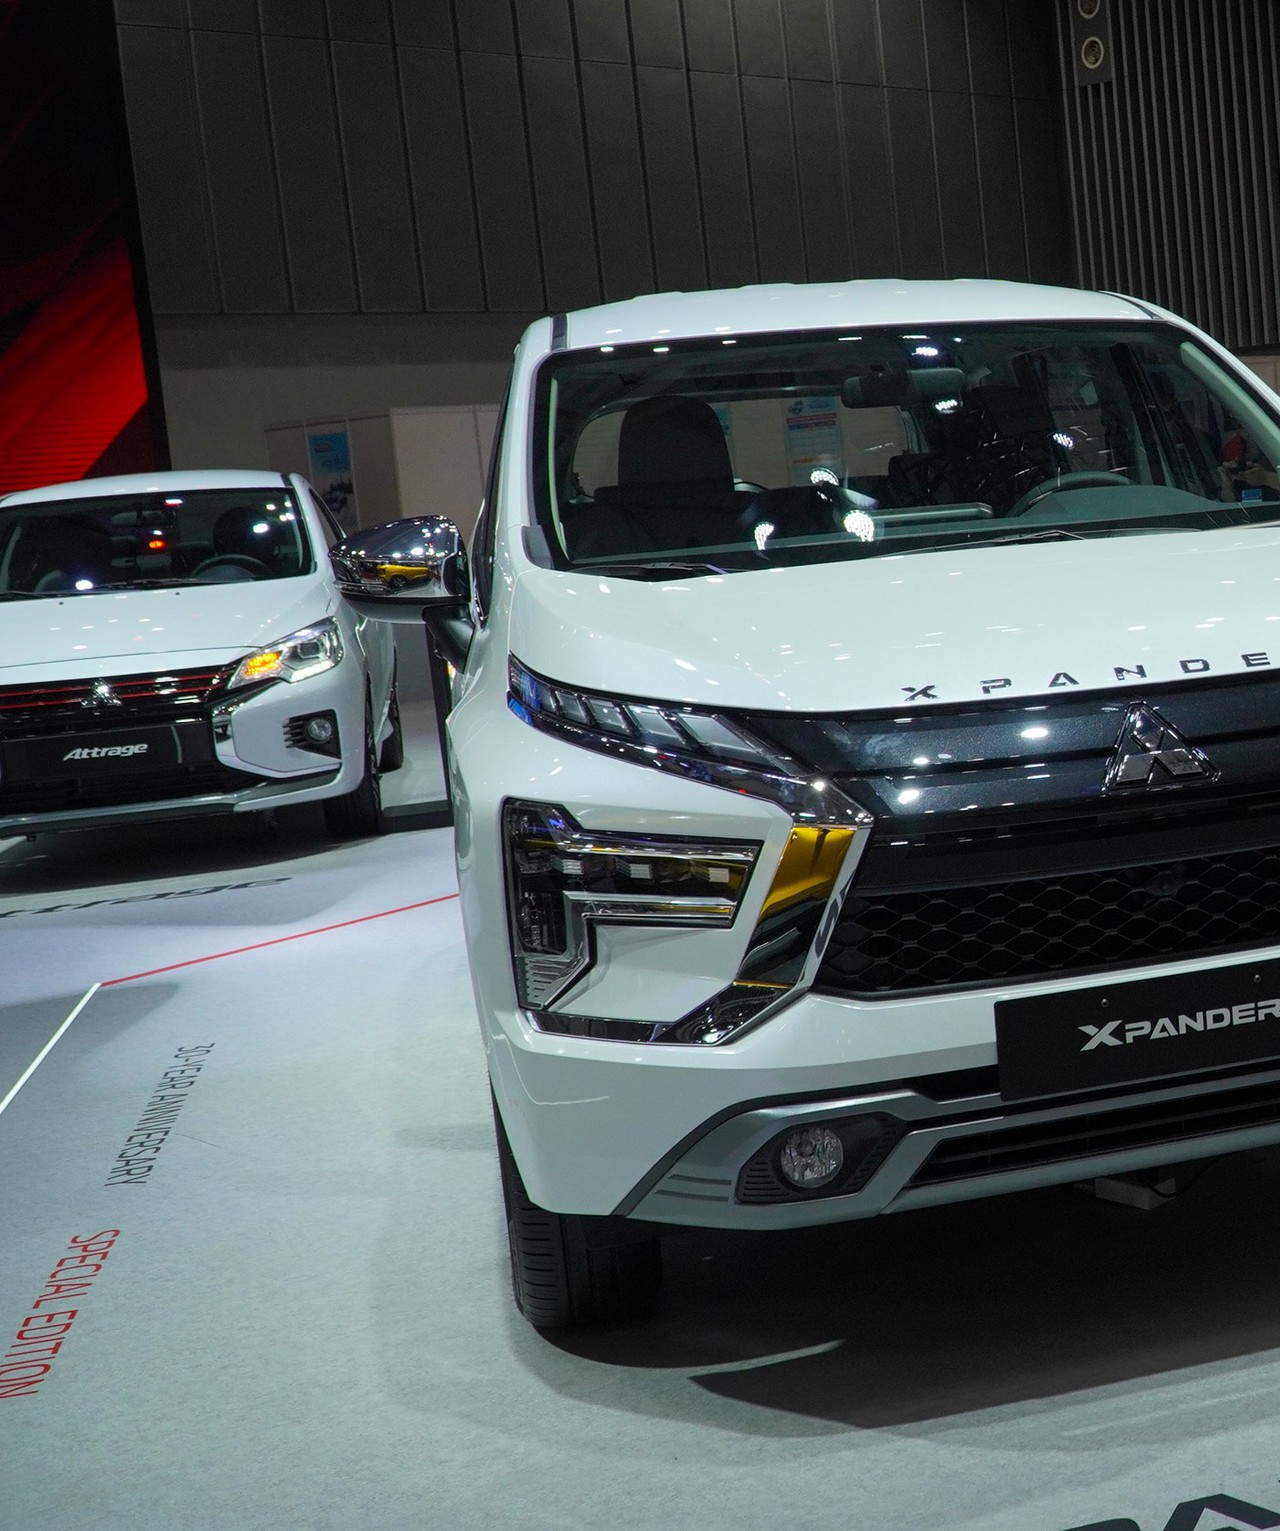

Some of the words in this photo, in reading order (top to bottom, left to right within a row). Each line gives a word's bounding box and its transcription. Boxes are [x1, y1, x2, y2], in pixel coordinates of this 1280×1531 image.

[63, 742, 148, 761] Attrage
[154, 1042, 216, 1093] 30-YEAR
[104, 1093, 189, 1187] ANNIVERSARY
[33, 1229, 121, 1309] SPECIAL
[0, 1309, 79, 1400] EDITION
